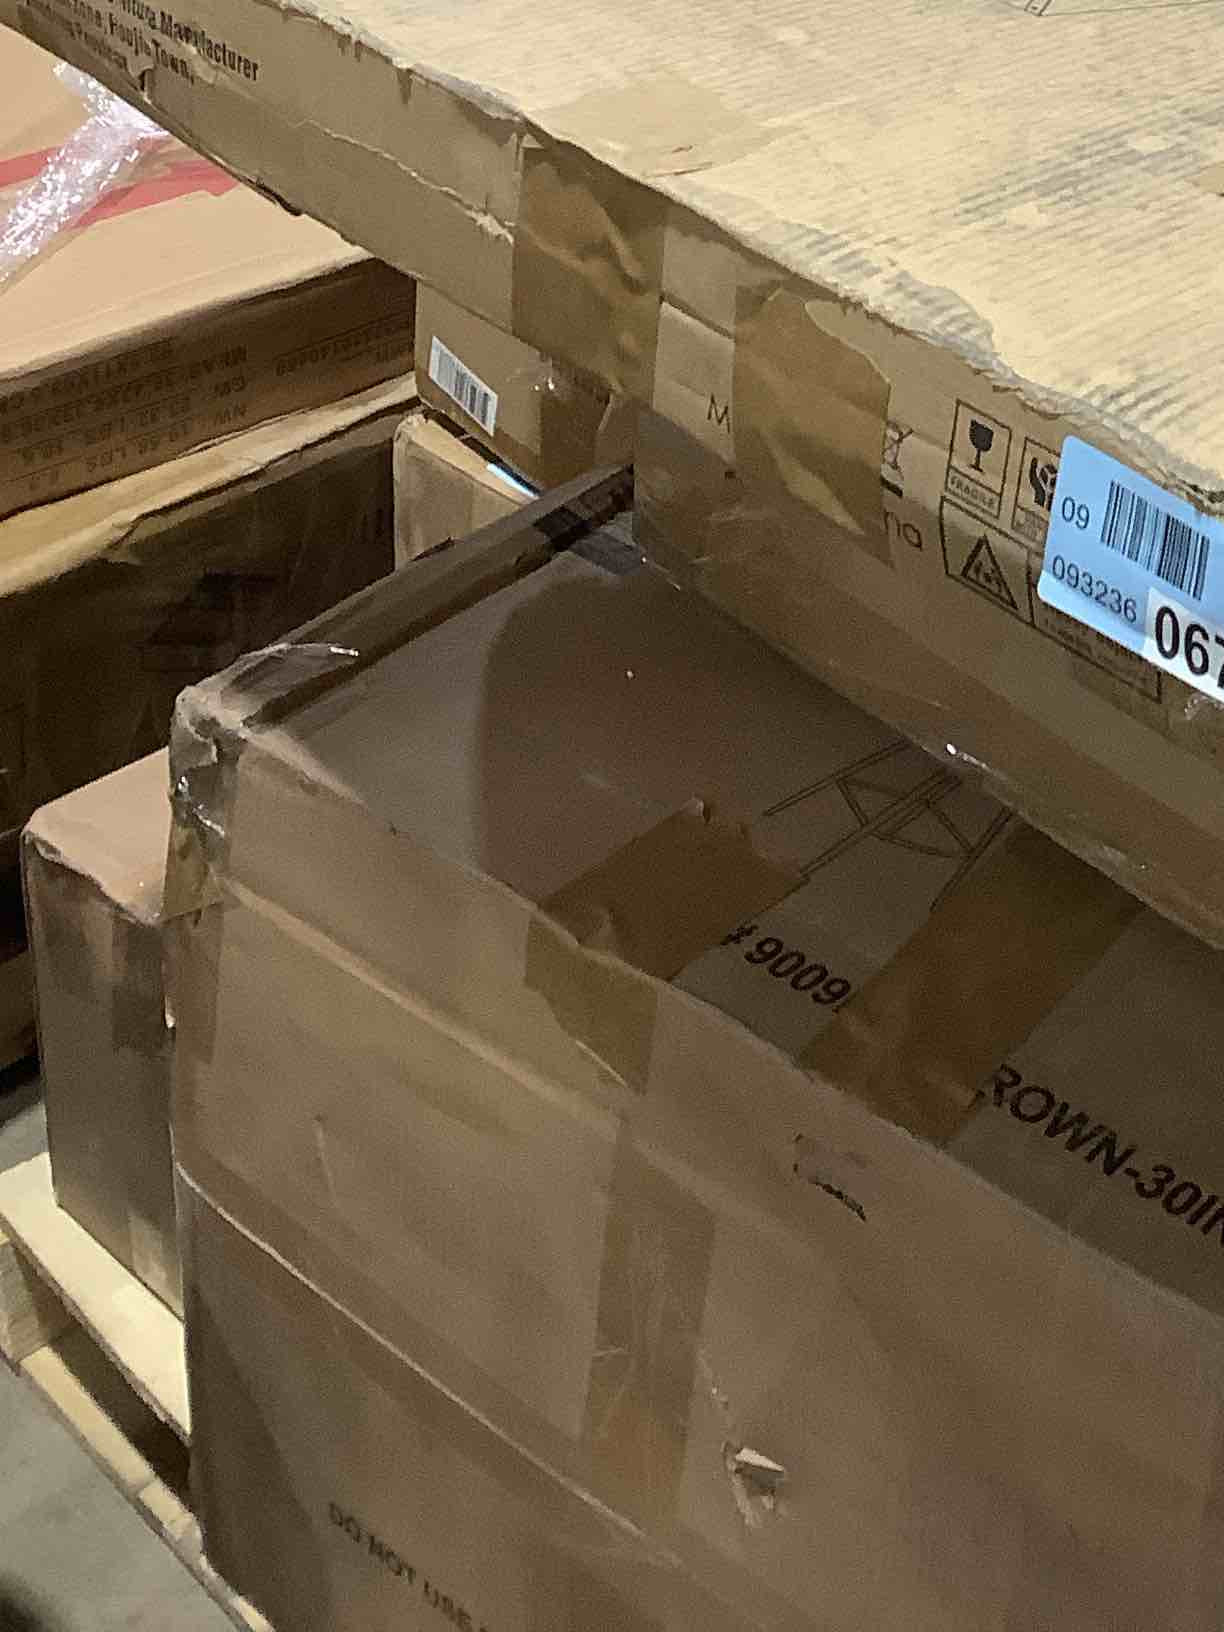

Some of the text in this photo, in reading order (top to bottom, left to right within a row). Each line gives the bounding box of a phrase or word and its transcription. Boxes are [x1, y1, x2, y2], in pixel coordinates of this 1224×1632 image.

[1061, 496, 1090, 531] 09
[1051, 555, 1137, 624] 093236
[328, 1501, 361, 1544] DO
